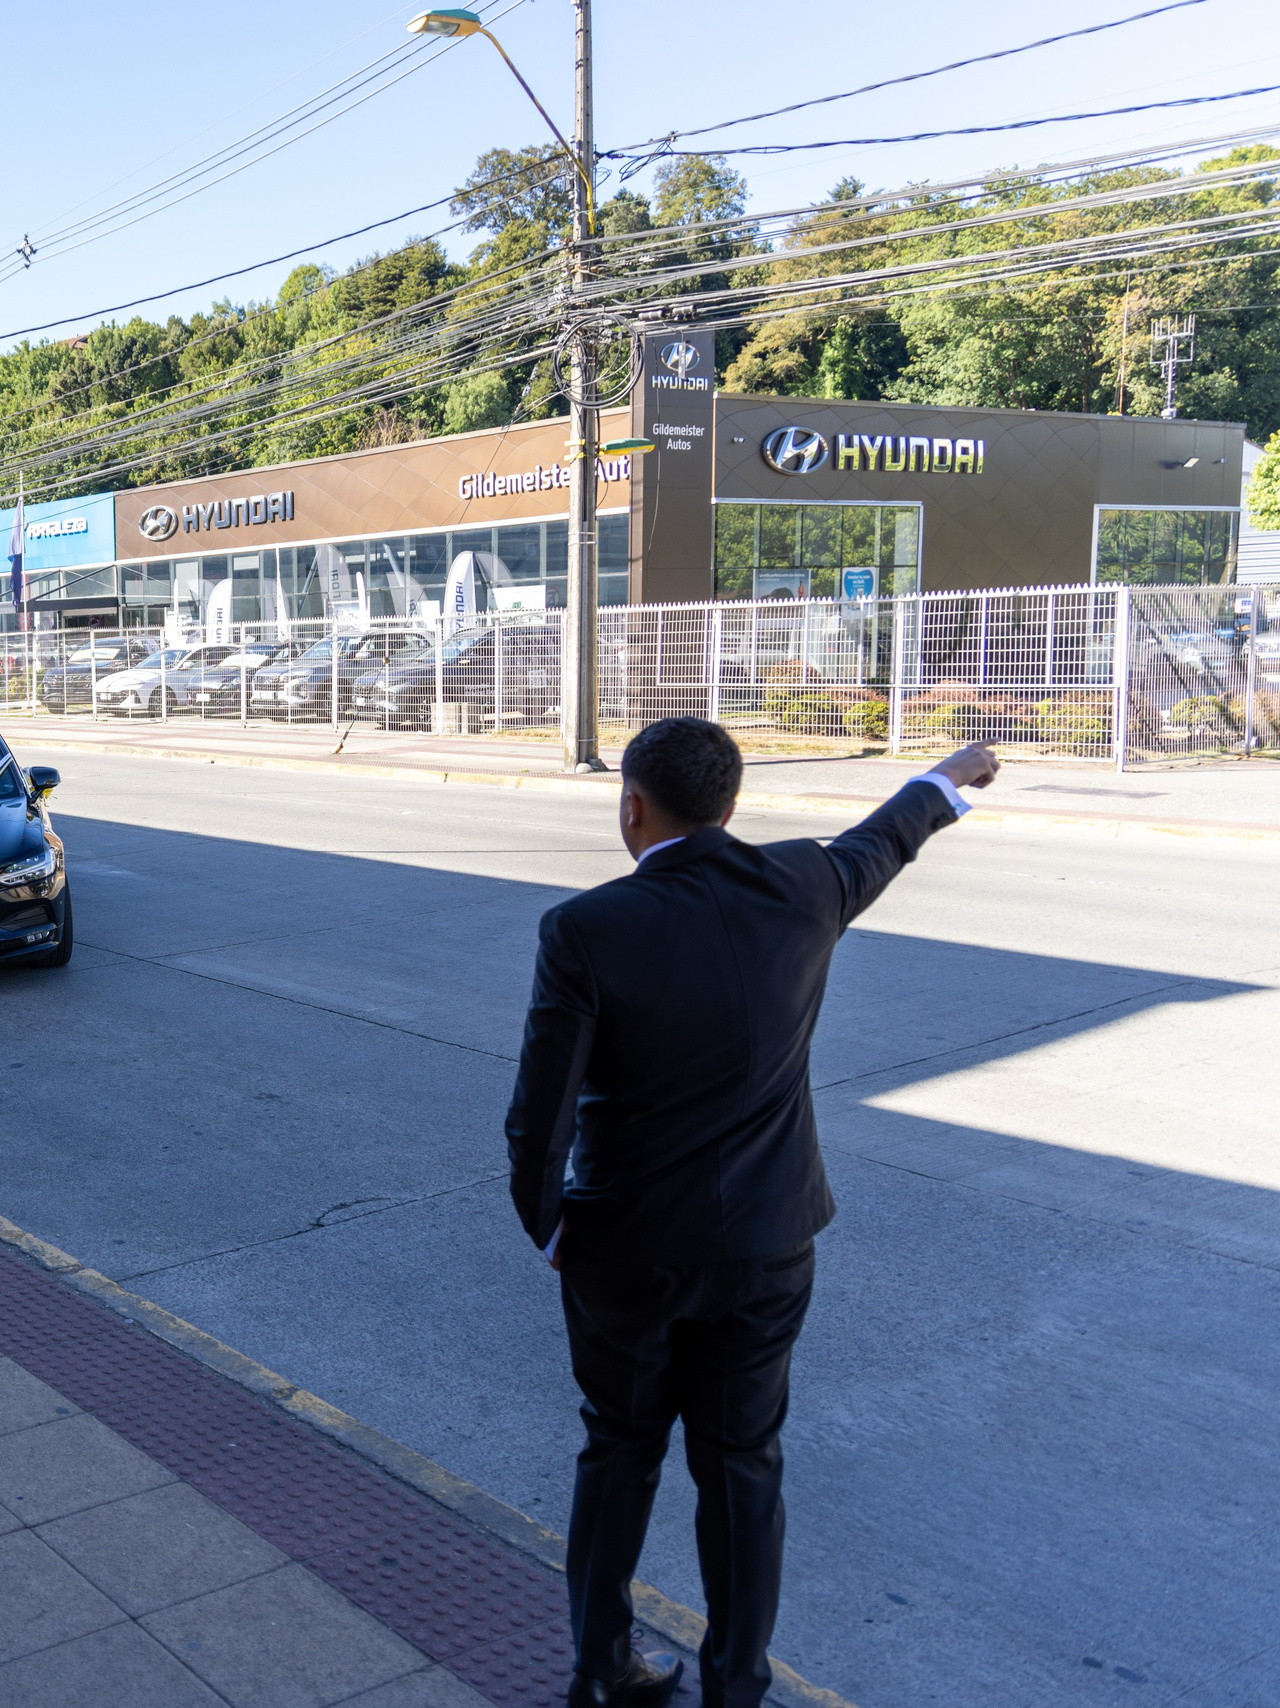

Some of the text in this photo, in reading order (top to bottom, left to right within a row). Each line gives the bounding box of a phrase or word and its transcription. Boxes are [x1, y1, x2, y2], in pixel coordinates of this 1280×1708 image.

[652, 375, 708, 391] HYUNDAI
[652, 423, 705, 437] Gildemeister
[666, 438, 691, 450] Autos
[836, 433, 985, 474] HYUNDAI
[458, 463, 570, 500] Gildemeiste
[182, 490, 294, 533] HYUNDAI
